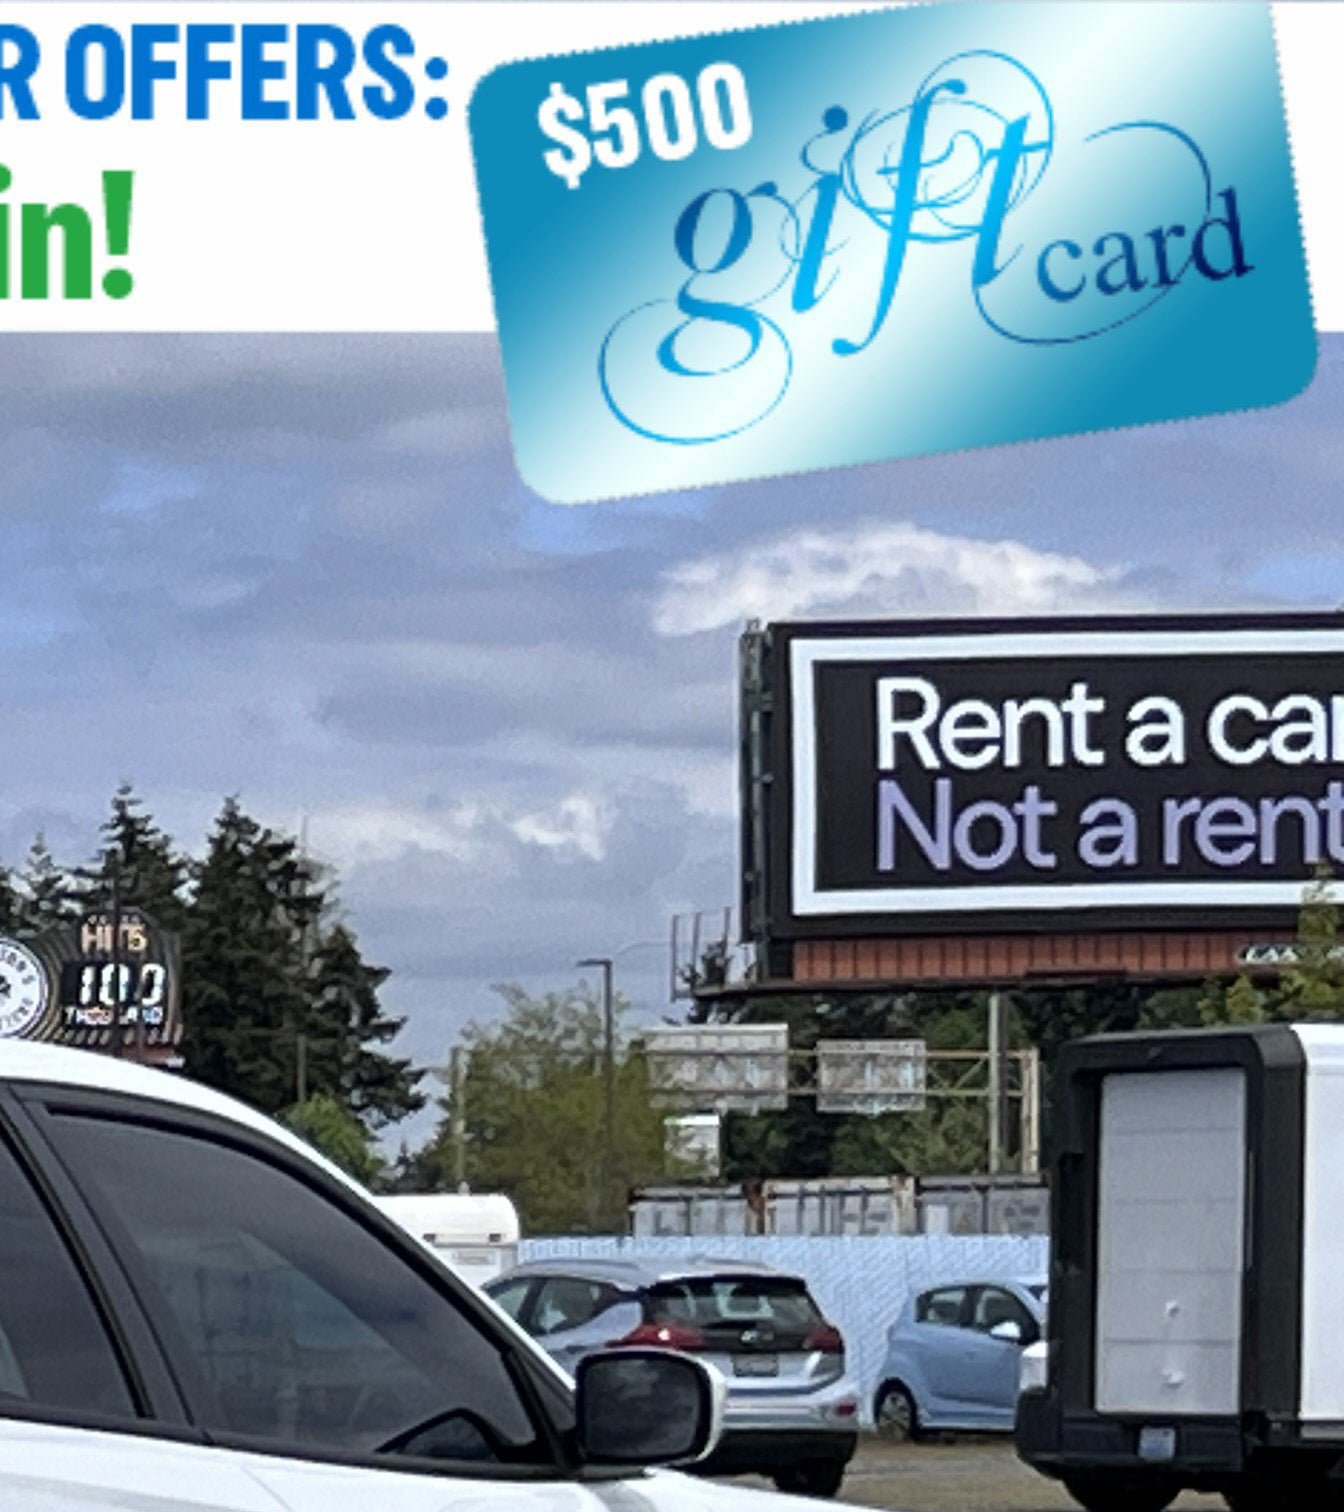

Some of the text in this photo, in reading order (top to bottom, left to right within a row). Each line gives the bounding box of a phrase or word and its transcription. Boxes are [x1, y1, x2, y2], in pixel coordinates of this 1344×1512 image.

[877, 677, 1105, 771] Rent
[1126, 696, 1186, 765] a
[877, 777, 1057, 871] Not
[1078, 798, 1138, 869] a
